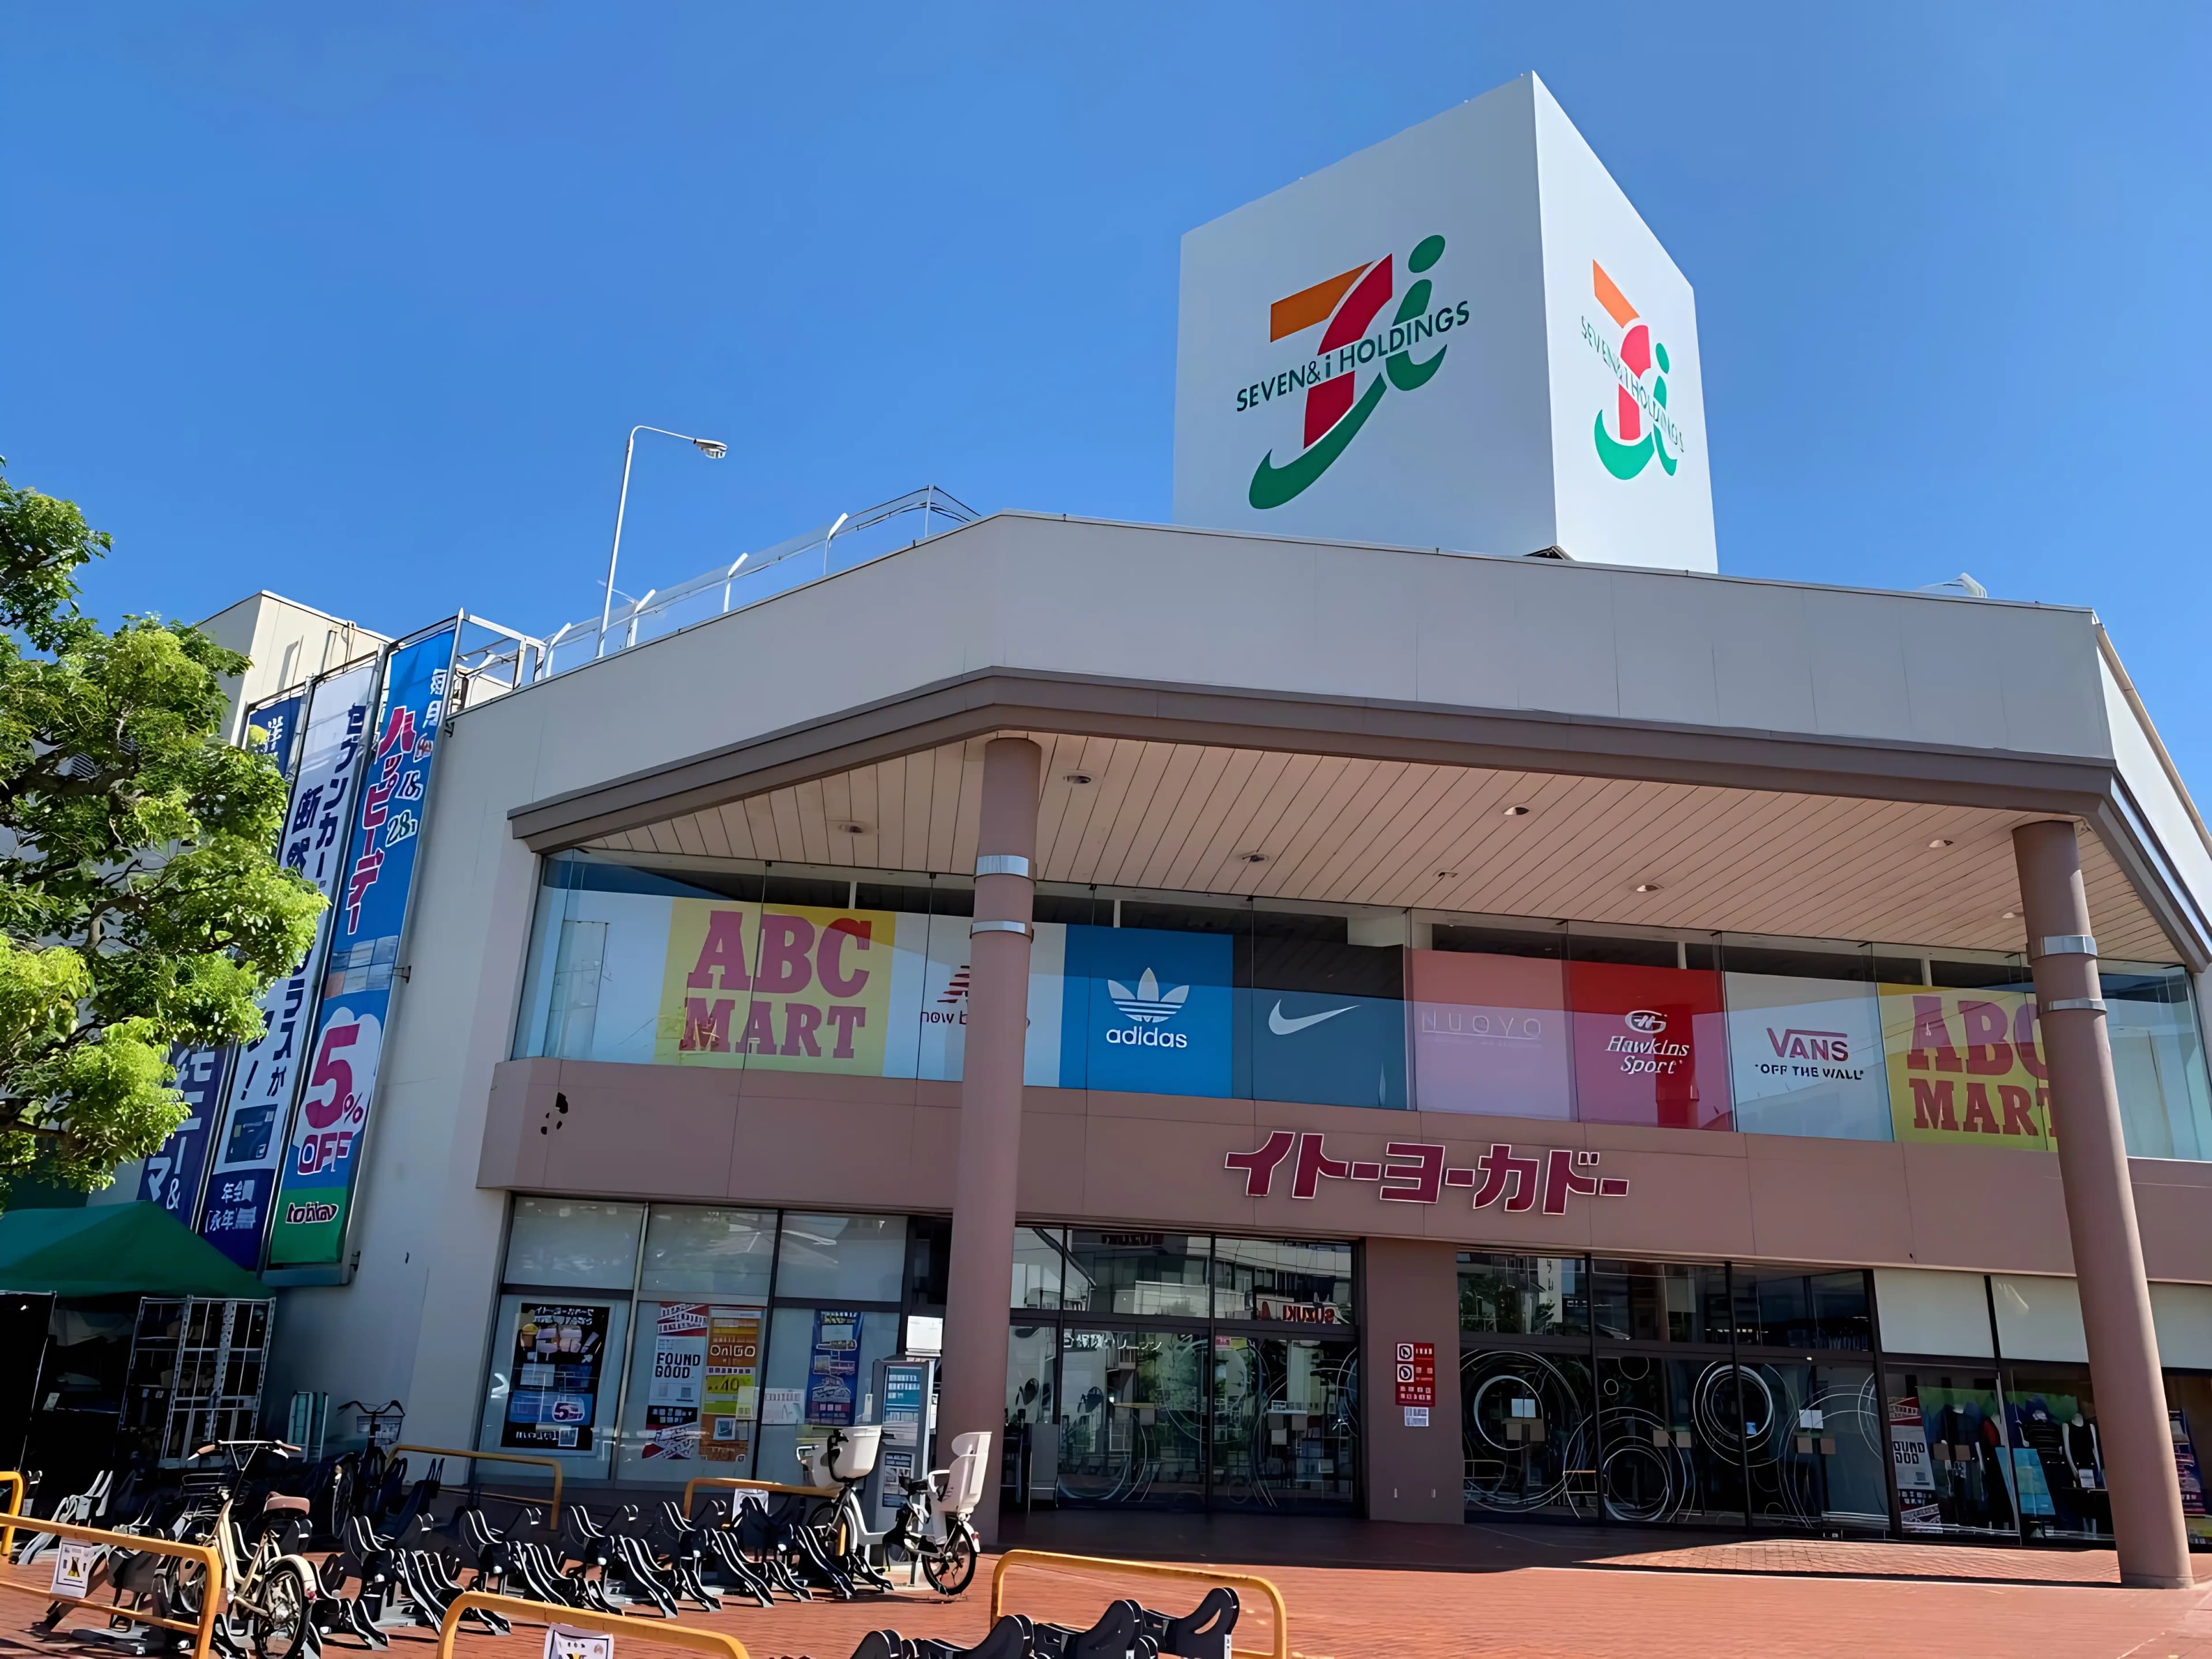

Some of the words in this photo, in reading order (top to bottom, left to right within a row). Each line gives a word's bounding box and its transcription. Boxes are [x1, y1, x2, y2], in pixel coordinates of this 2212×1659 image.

[1340, 301, 1469, 373] HOLDINGS
[687, 910, 872, 998] ABC
[679, 997, 866, 1059] MART
[1105, 1026, 1188, 1048] adidas
[1766, 1027, 1849, 1062] VANS
[1604, 1036, 1690, 1056] Hawkins
[1792, 1066, 1820, 1077] THE
[298, 1131, 354, 1176] OFF
[1225, 1131, 1629, 1215] イトーヨーカドー
[655, 1365, 691, 1378] GOOD
[657, 1352, 701, 1366] FOUND
